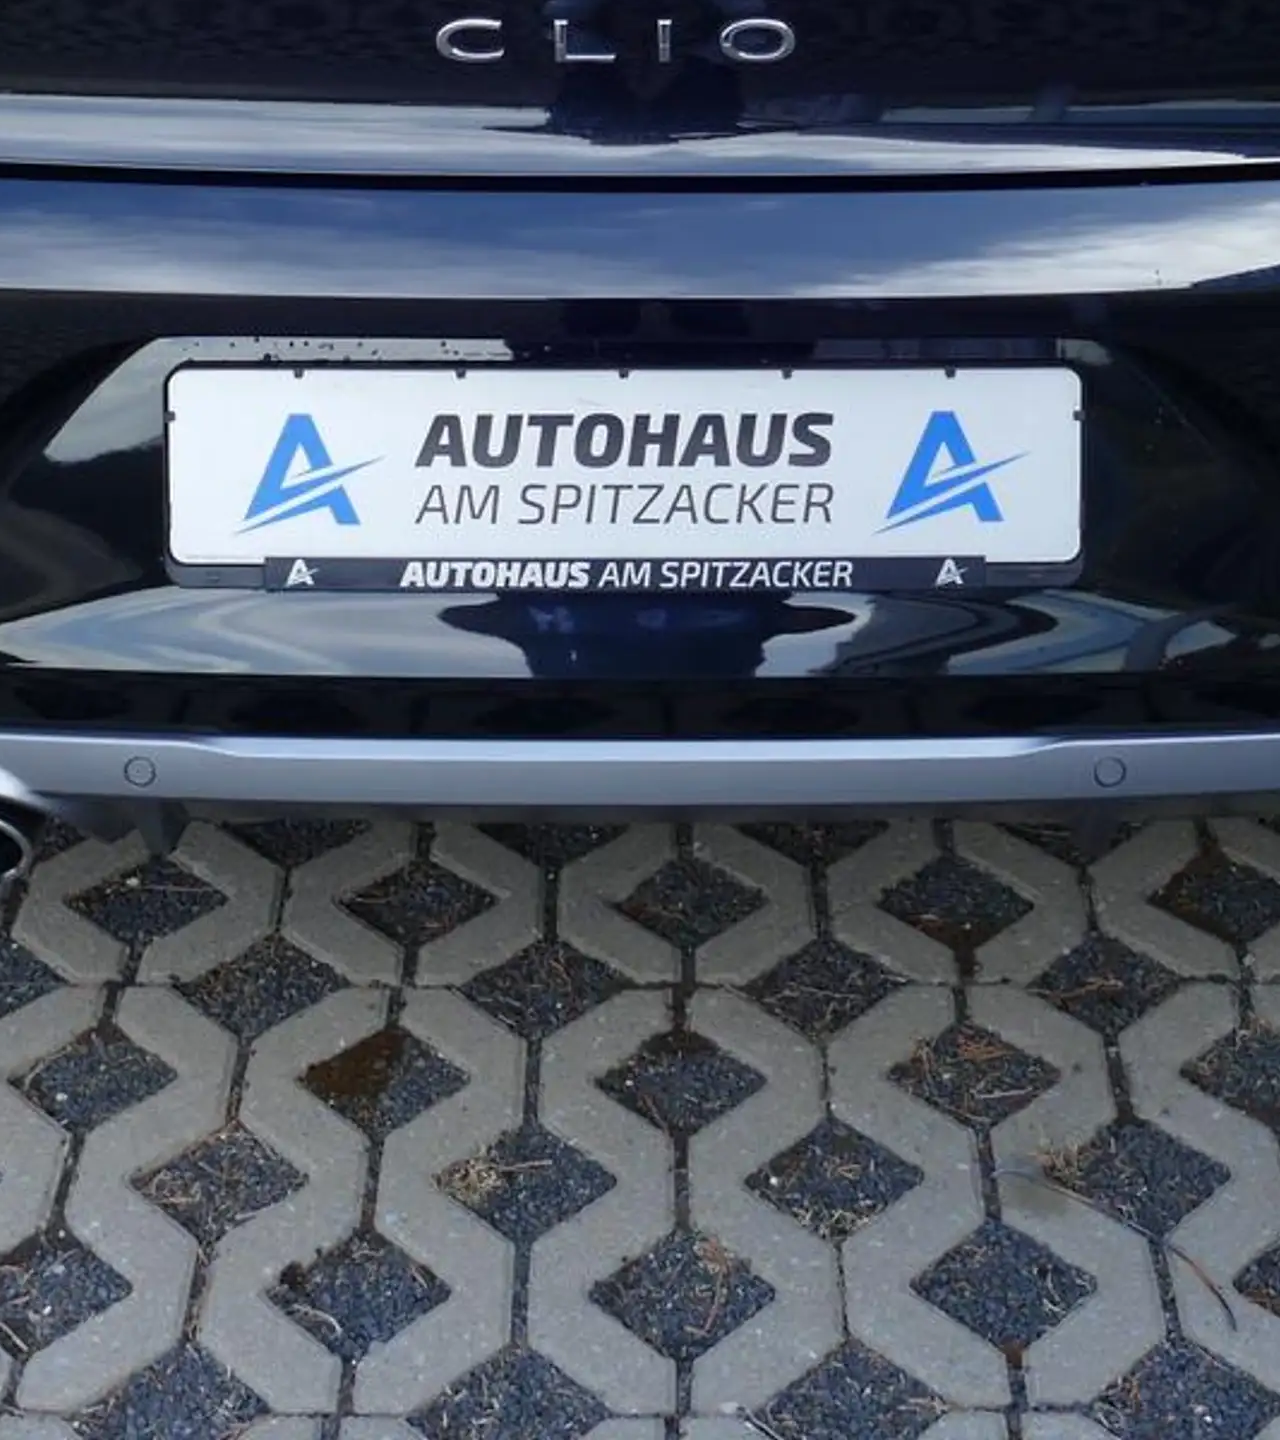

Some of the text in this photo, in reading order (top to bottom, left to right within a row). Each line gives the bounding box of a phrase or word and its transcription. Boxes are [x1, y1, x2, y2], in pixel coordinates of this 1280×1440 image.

[436, 18, 796, 63] CLIO
[415, 412, 834, 468] AUTOHAUS
[415, 482, 834, 525] AM SPITZACKER
[400, 561, 853, 588] AUTOHAUS AM SPITZACKER
